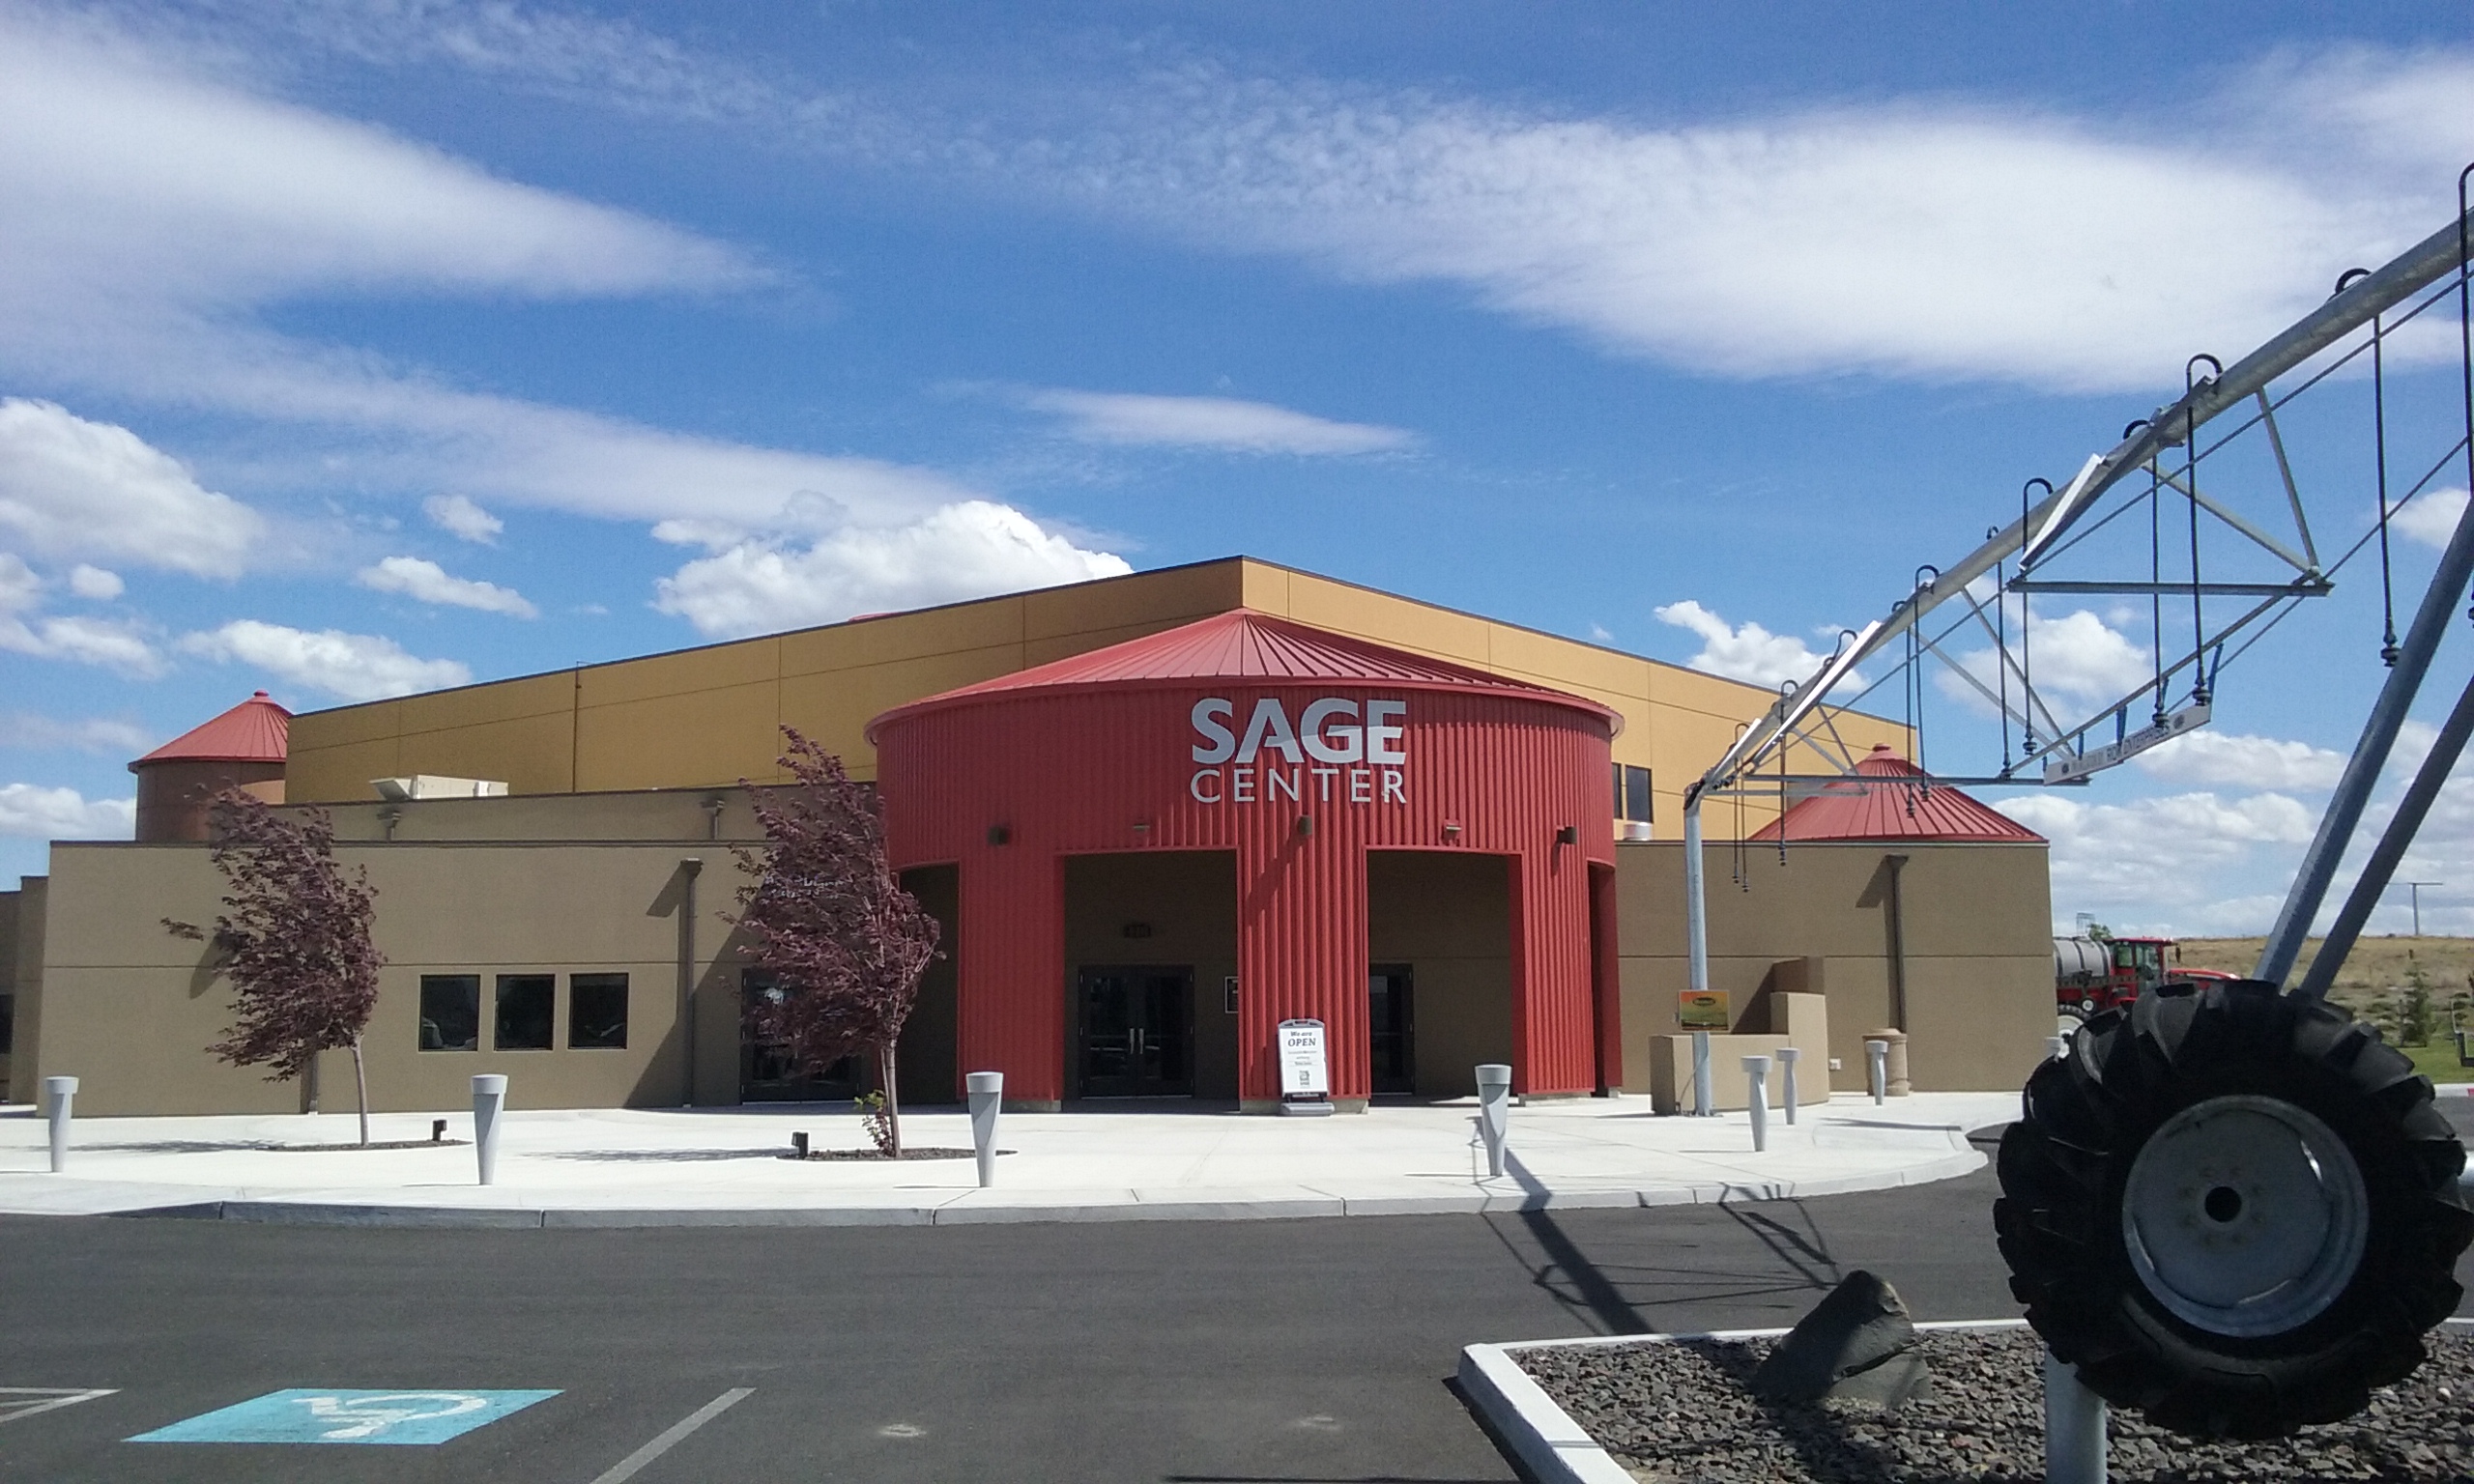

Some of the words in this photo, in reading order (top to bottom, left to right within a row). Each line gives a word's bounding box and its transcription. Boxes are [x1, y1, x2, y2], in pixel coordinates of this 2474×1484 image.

[1191, 698, 1407, 764] SAGE
[1190, 768, 1407, 804] CENTER
[1288, 1038, 1316, 1046] OPEN
